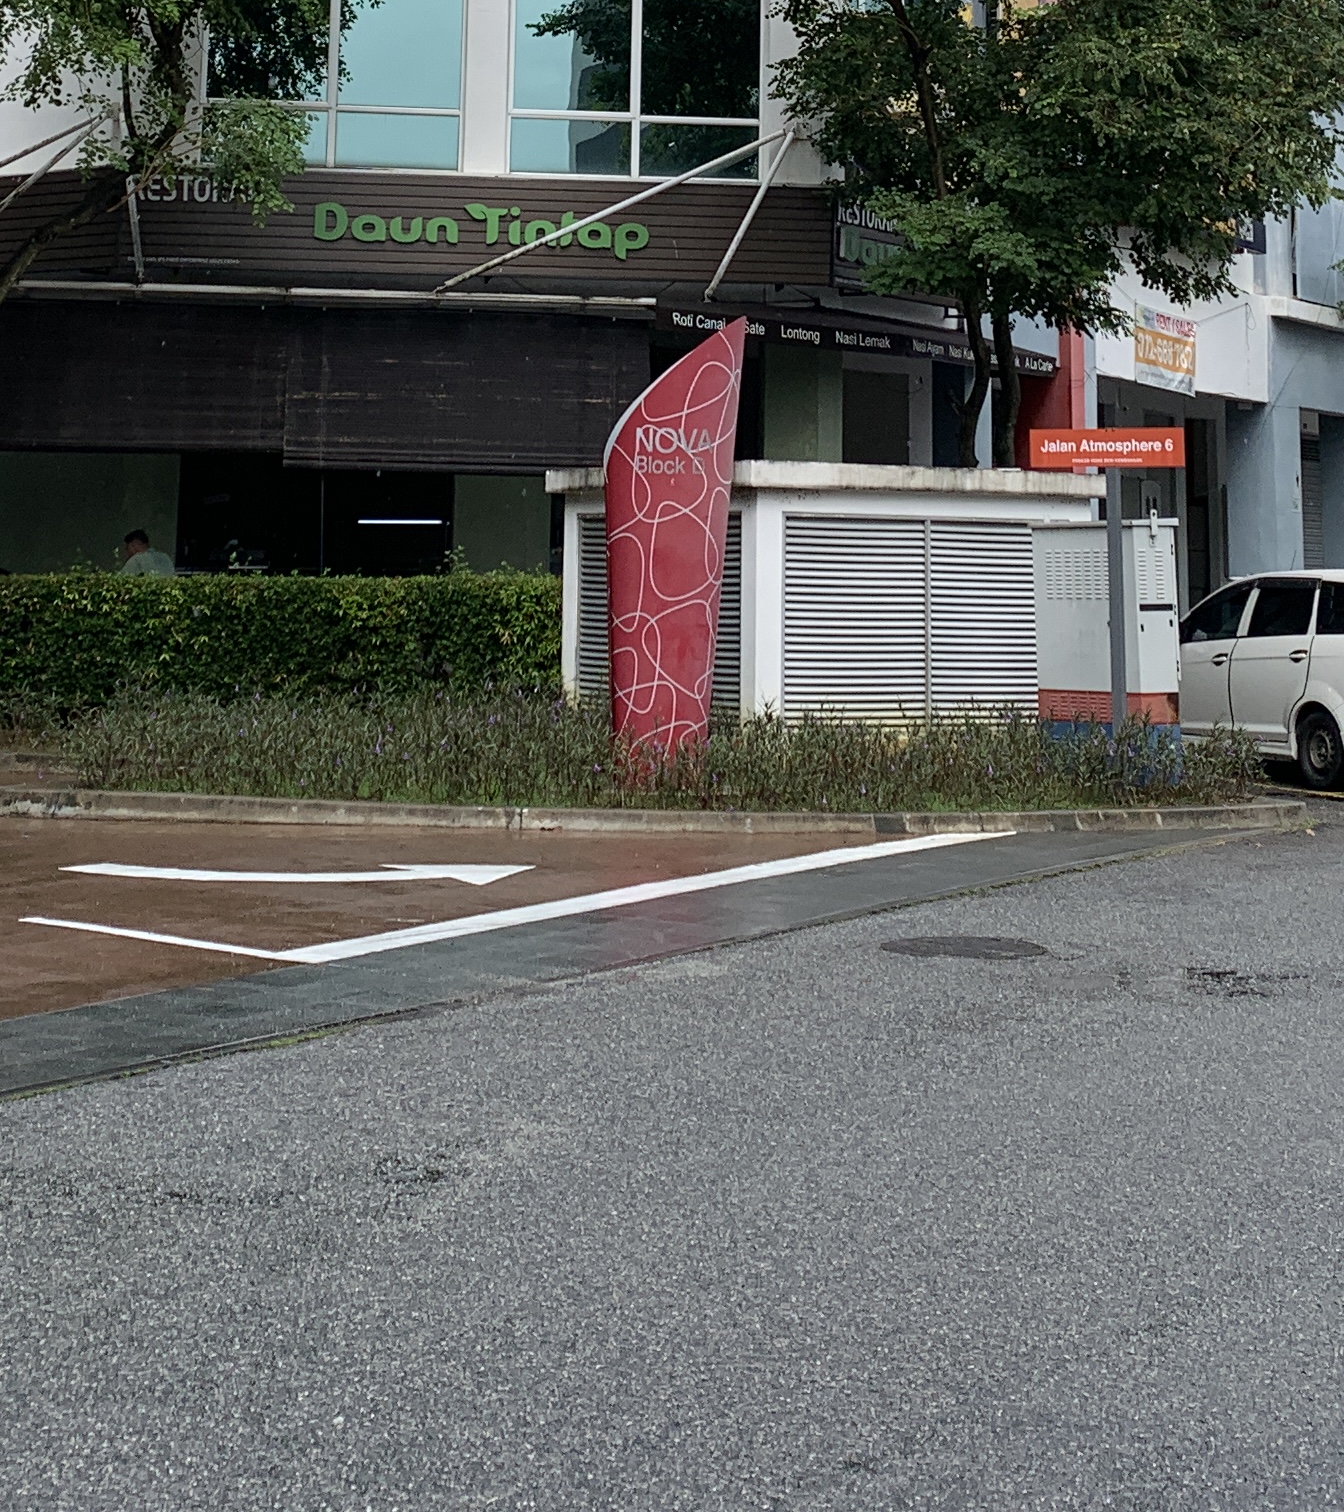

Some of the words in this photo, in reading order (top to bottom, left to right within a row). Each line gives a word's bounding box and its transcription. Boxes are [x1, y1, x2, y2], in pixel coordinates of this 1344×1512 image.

[313, 201, 458, 245] Daun
[463, 202, 650, 261] Tintap
[672, 312, 693, 328] Roti
[696, 315, 726, 331] Canai
[781, 325, 820, 344] Lontong
[836, 331, 857, 345] Nasi
[859, 333, 891, 349] Lemak
[636, 427, 713, 454] NOVA
[1040, 439, 1076, 453] Jalan
[1079, 438, 1162, 455] Atmosphere
[1164, 438, 1174, 452] 6
[636, 455, 686, 475] Block
